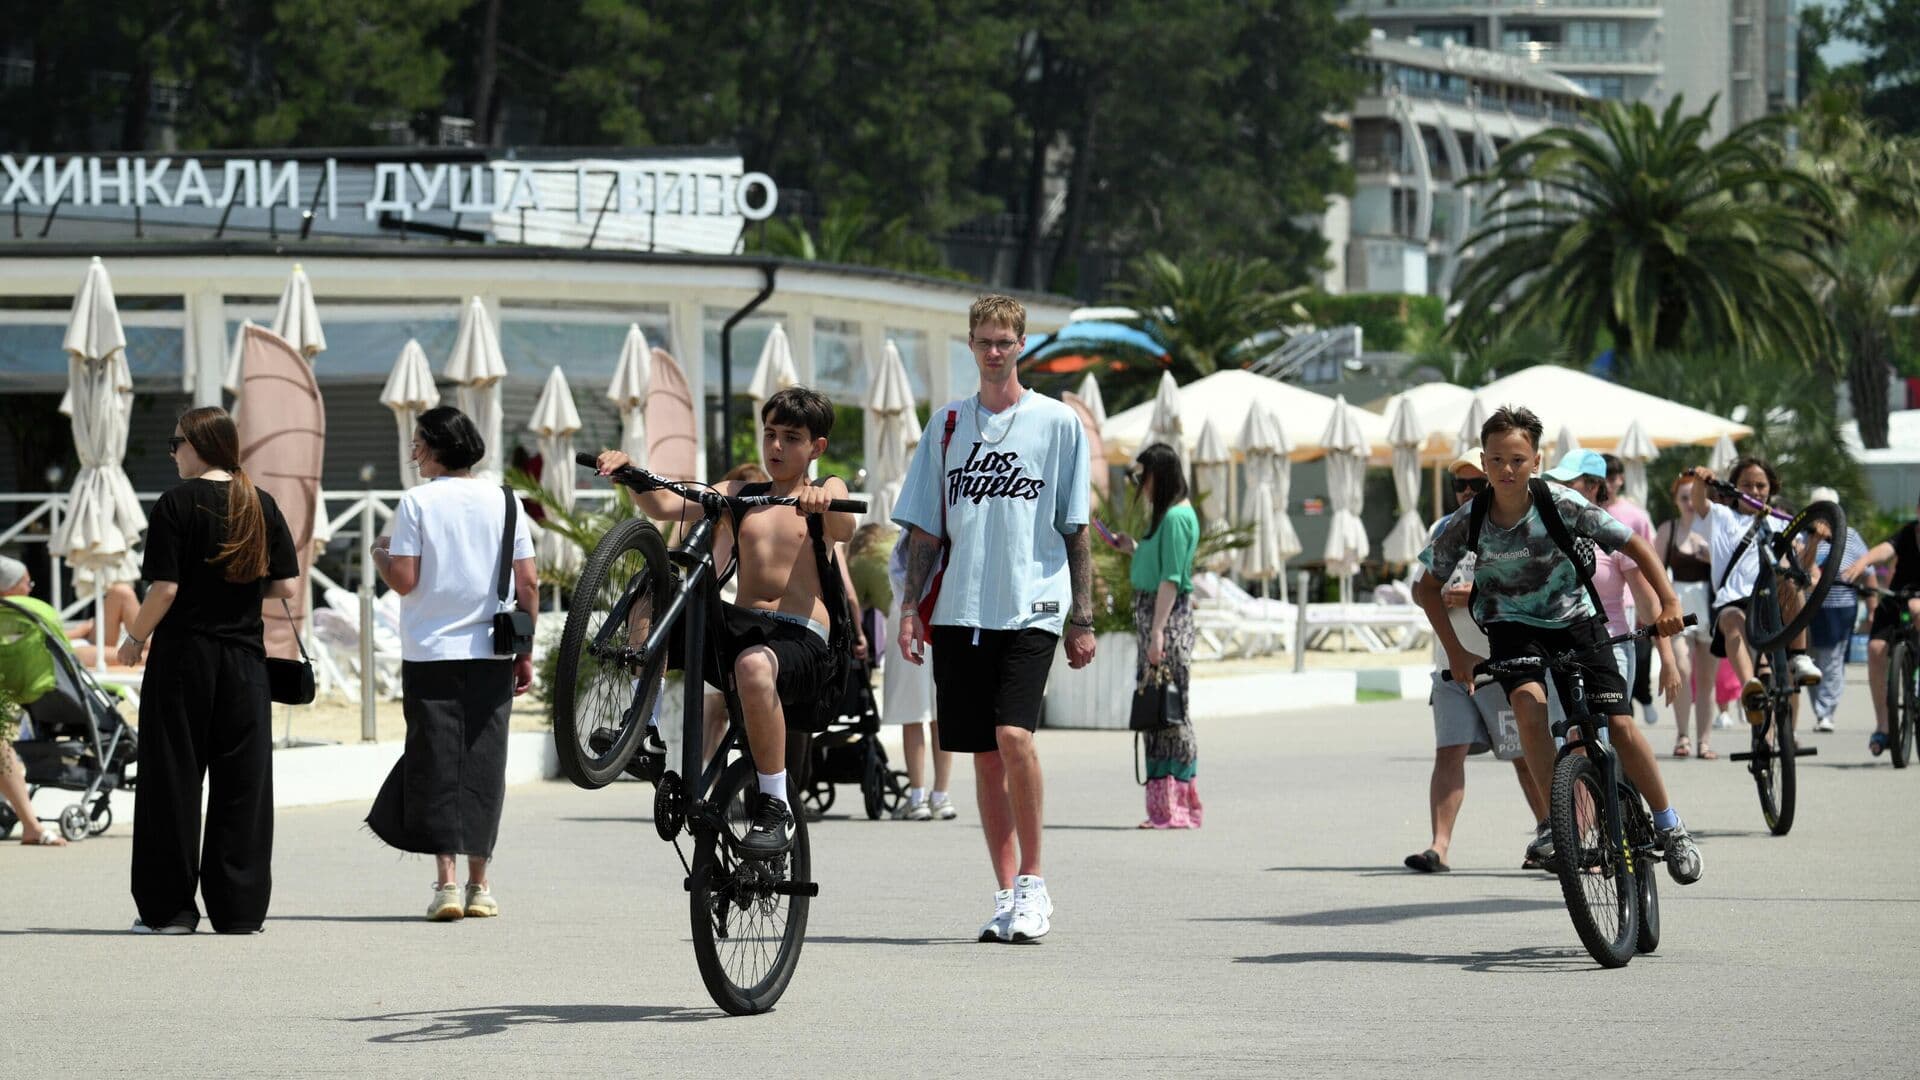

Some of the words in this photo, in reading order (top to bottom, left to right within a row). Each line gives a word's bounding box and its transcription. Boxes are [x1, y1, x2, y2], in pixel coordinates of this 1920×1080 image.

[0, 154, 299, 208] ХИНКАЛИ
[365, 162, 545, 222] ДУША
[616, 170, 779, 220] ВИНО
[963, 441, 1018, 474] Los
[947, 467, 1046, 507] Angeles
